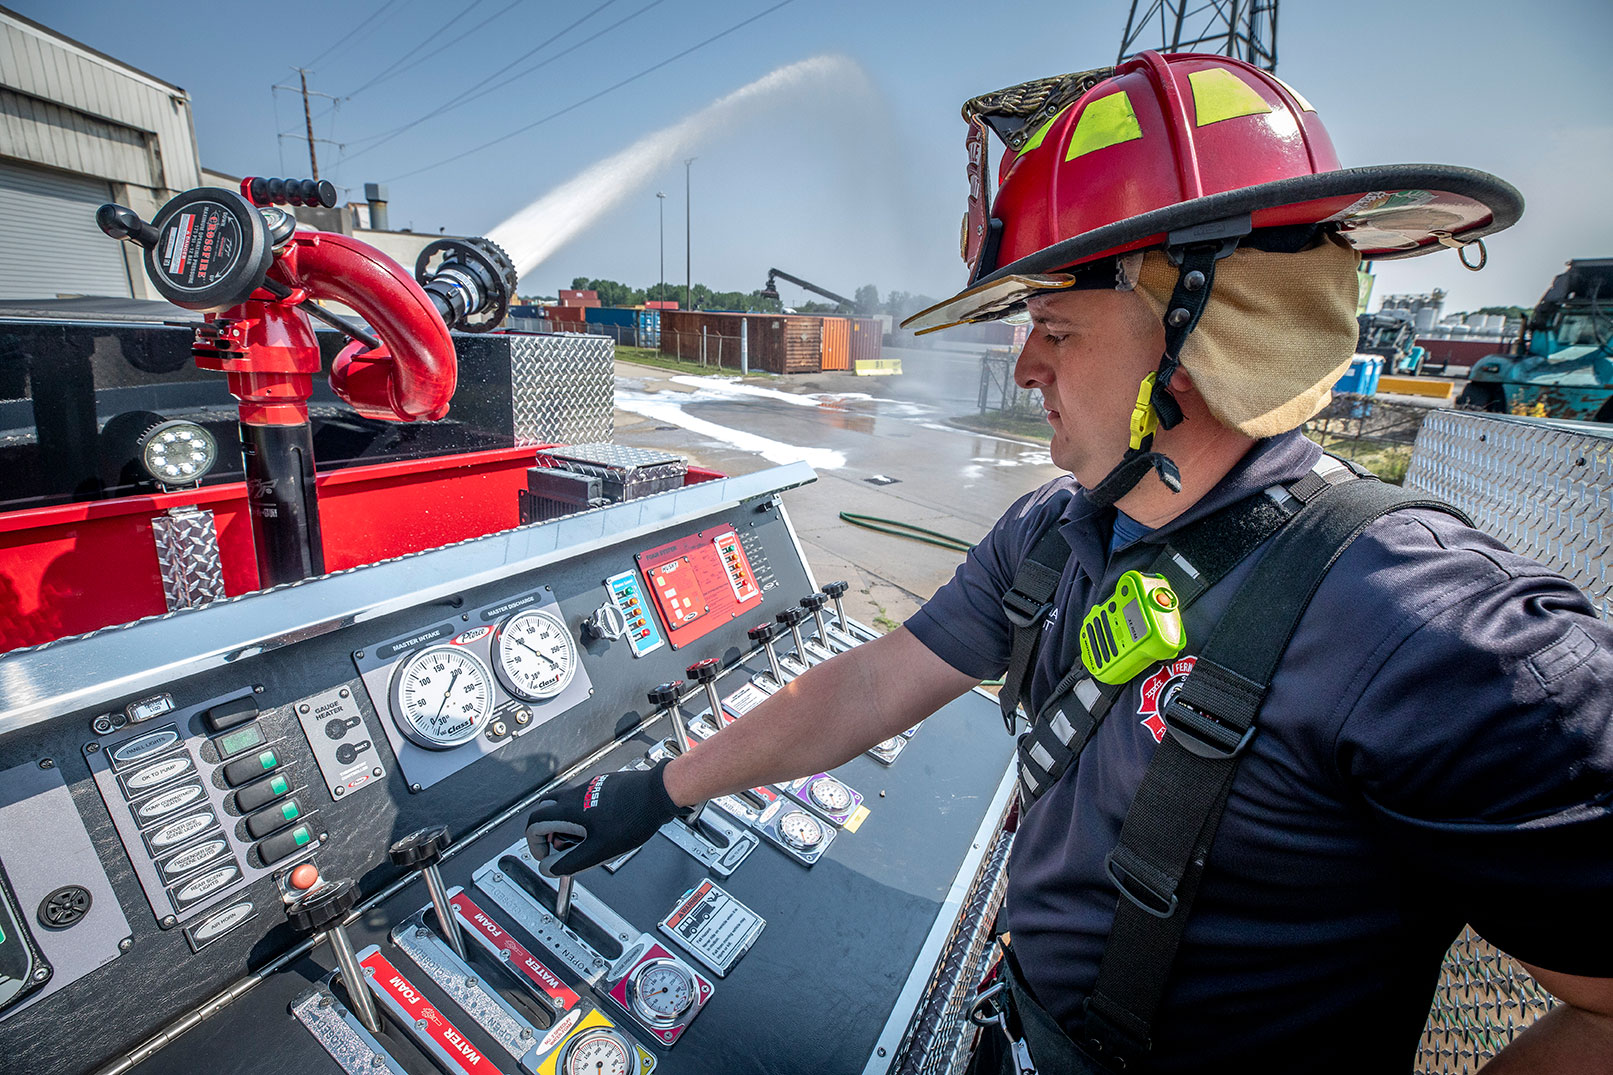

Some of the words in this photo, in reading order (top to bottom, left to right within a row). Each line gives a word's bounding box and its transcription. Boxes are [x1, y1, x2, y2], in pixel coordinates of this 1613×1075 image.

[199, 206, 208, 231] MAXIMUM
[220, 211, 228, 226] DOWN
[181, 235, 189, 259] DANGER
[194, 231, 204, 257] OPERATING
[197, 215, 217, 279] CROSSFIRE
[187, 258, 197, 284] PRESSURE
[208, 274, 214, 282] UP
[659, 545, 677, 556] SYSTEM
[487, 605, 507, 616] MASTER
[508, 596, 534, 611] DISCHARGE
[461, 627, 485, 643] Pierce
[526, 626, 536, 634] 150
[540, 631, 550, 640] 200
[393, 637, 417, 651] MASTER
[417, 630, 440, 645] INTAKE
[550, 646, 560, 654] 250
[514, 656, 522, 664] 50
[1084, 640, 1095, 670] MOTOROLA
[433, 664, 445, 673] 150
[450, 668, 462, 678] 200
[549, 662, 559, 671] 300
[419, 677, 431, 687] 100
[463, 684, 475, 693] 250
[314, 700, 339, 714] GAUGE
[417, 699, 427, 707] 50
[461, 703, 473, 713] 300
[314, 705, 344, 721] HEATER
[430, 718, 436, 726] 0
[125, 743, 146, 755] PANEL
[145, 735, 166, 748] LIGHTS
[353, 742, 368, 751] FAULT
[149, 770, 159, 778] TO
[158, 763, 177, 775] PUMP
[144, 802, 161, 812] PUMP
[159, 787, 197, 806] COMPARTMENT
[162, 797, 183, 808] HEATER
[165, 824, 185, 835] DRIVER
[183, 818, 197, 827] SIDE
[165, 829, 183, 840] SCENE
[181, 821, 202, 833] LIGHTS
[172, 849, 205, 867] PASSENGER
[203, 844, 217, 853] SIDE
[178, 857, 197, 868] SCENE
[195, 849, 216, 861] LIGHTS
[189, 880, 205, 891] REAR
[204, 871, 225, 884] SCENE
[198, 879, 219, 891] LIGHTS
[492, 887, 522, 915] CLOSED
[682, 891, 703, 913] WARNING
[210, 921, 221, 930] AIR
[219, 912, 237, 924] HORN
[473, 911, 502, 938] FOAM
[702, 939, 711, 948] Never
[718, 919, 727, 929] vehicle
[723, 932, 733, 943] moving
[731, 923, 740, 932] vehicle
[412, 947, 445, 977] CLOSED
[561, 947, 585, 971] OPEN
[716, 950, 725, 958] injure
[524, 955, 559, 989] WATER
[388, 973, 421, 1005] FOAM
[318, 1020, 349, 1053] CLOSED
[486, 1016, 513, 1042] OPEN
[442, 1026, 482, 1065] WATER
